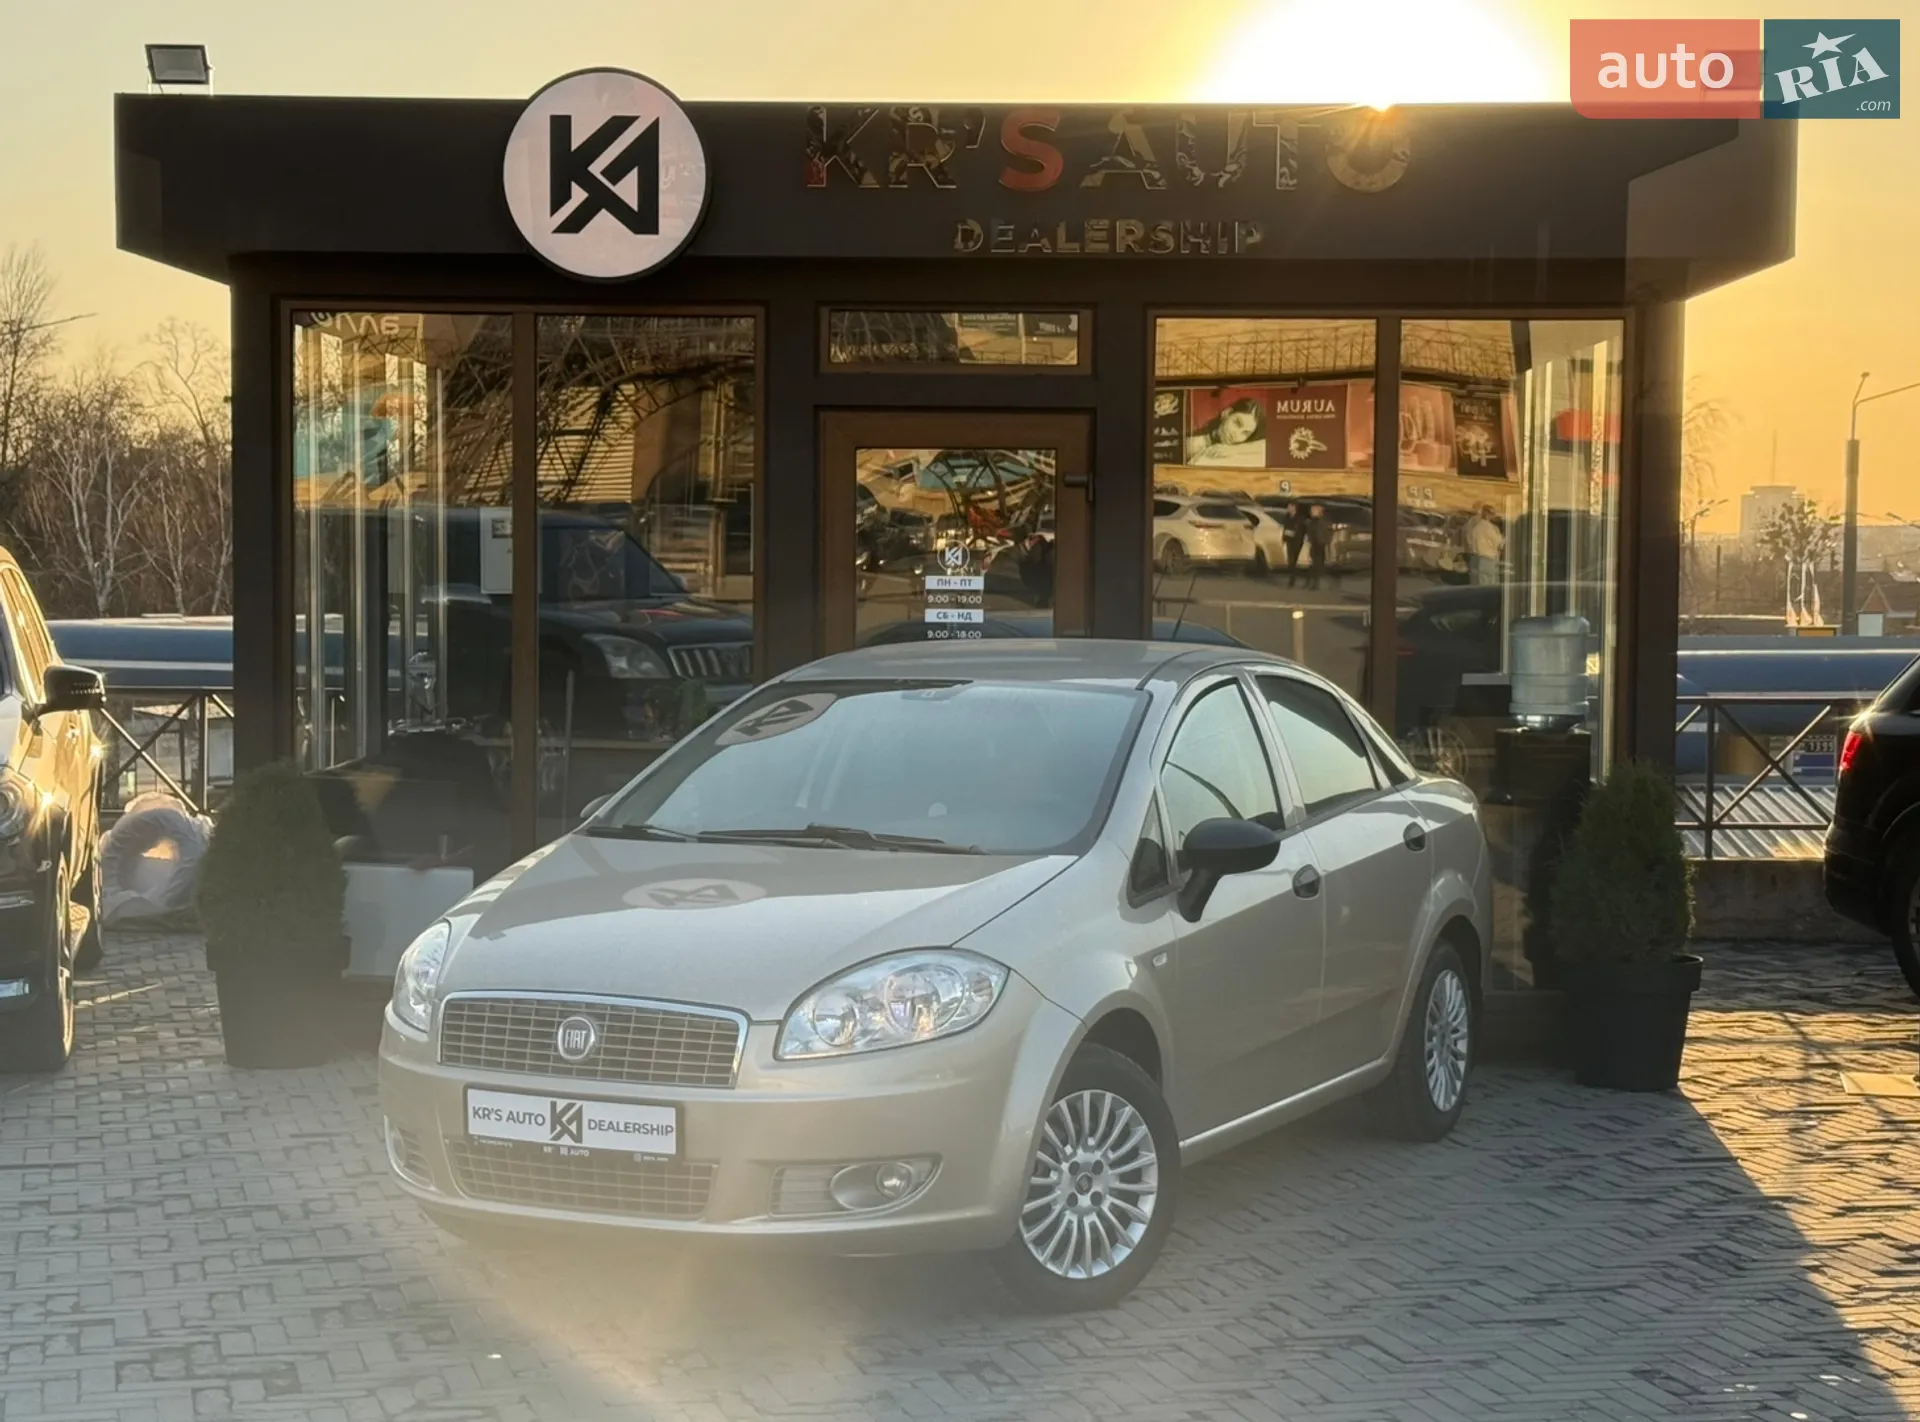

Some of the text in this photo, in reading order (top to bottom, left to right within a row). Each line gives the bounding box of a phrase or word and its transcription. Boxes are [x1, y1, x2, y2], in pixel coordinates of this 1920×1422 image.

[804, 105, 1413, 194] KR'S AUTO
[953, 217, 1262, 255] DEALERSHIP
[936, 578, 951, 587] ПН
[959, 578, 973, 587] ПТ
[936, 611, 949, 620] СБ
[957, 611, 973, 621] НД
[564, 1029, 587, 1049] FIAT
[472, 1106, 502, 1122] KR'S
[506, 1110, 546, 1127] AUTO
[587, 1118, 675, 1136] DEALERSHIP
